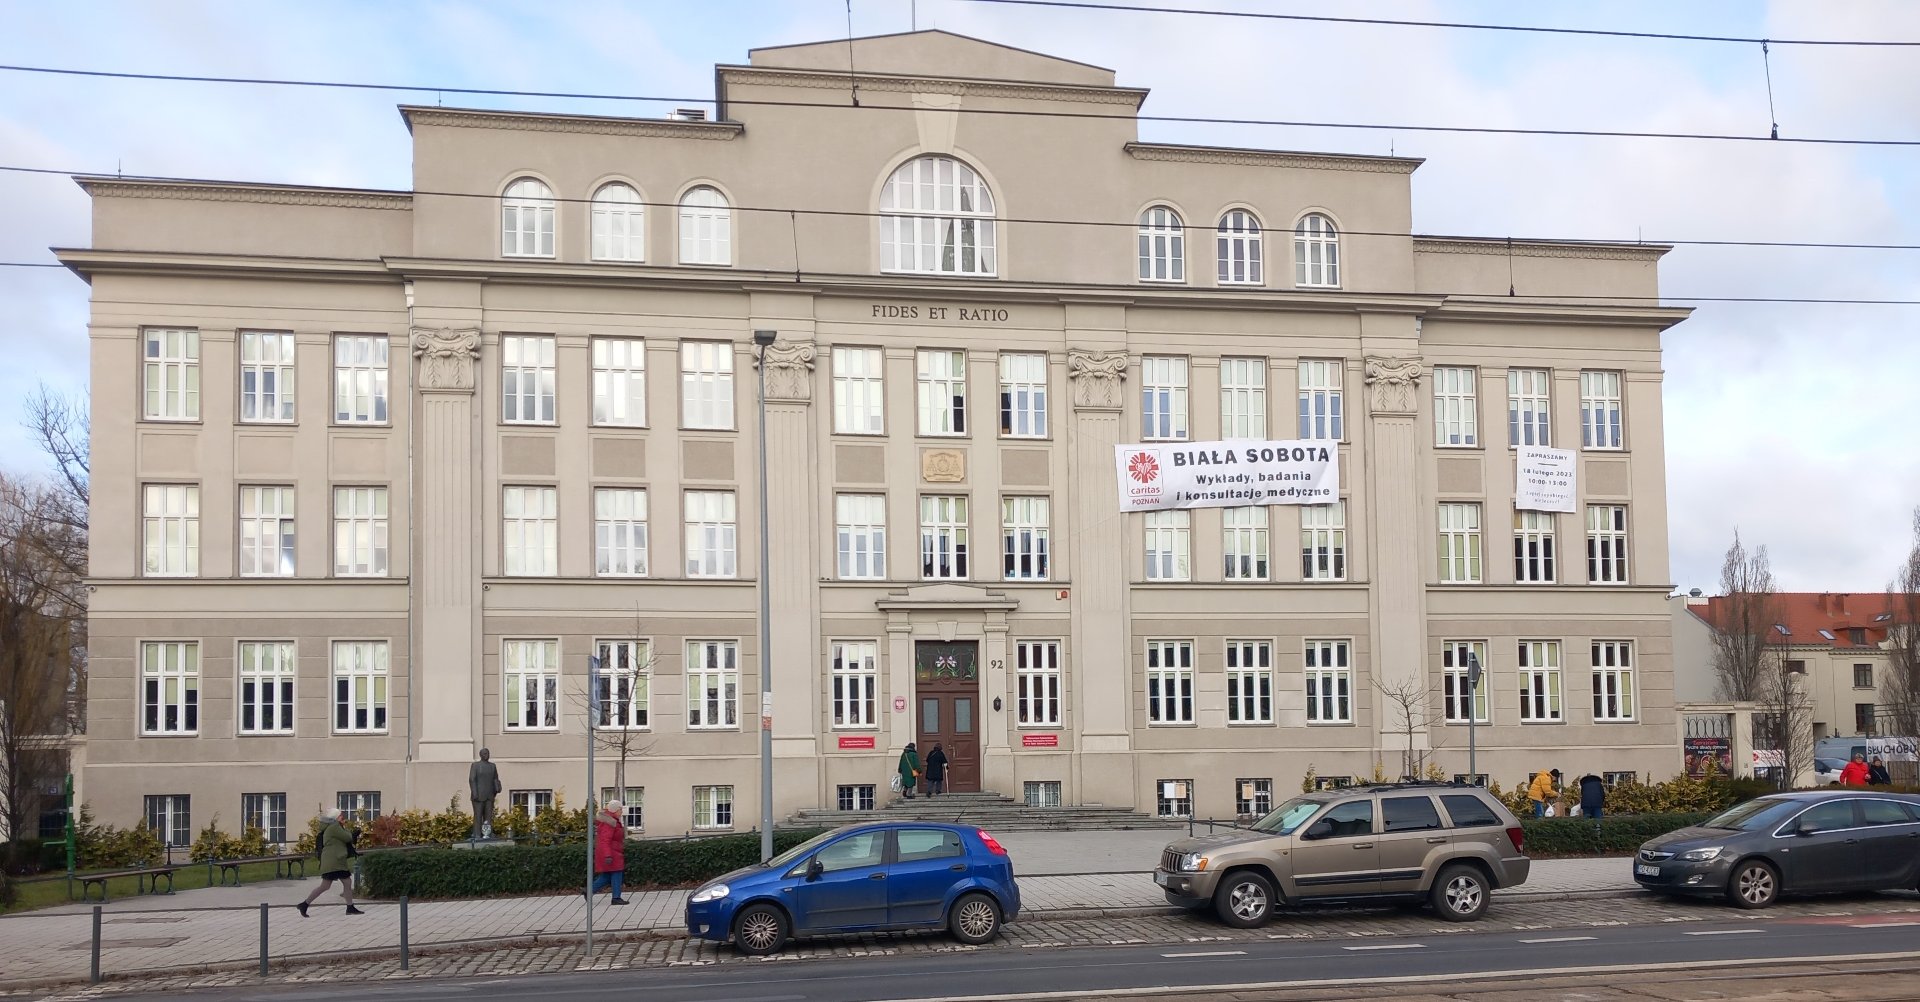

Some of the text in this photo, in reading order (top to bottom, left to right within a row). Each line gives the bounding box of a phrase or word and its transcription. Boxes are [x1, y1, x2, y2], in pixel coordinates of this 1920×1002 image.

[872, 305, 1009, 322] FIDES ET RATIO
[1173, 446, 1330, 466] BIAŁA SOBOTA
[1196, 471, 1312, 486] Wykłady, badania
[1532, 469, 1554, 477] lutego
[1131, 486, 1161, 495] caritas
[1176, 487, 1331, 501] i konsultacje medyczne
[1132, 497, 1160, 505] POZNAŃ
[991, 660, 1004, 669] 92
